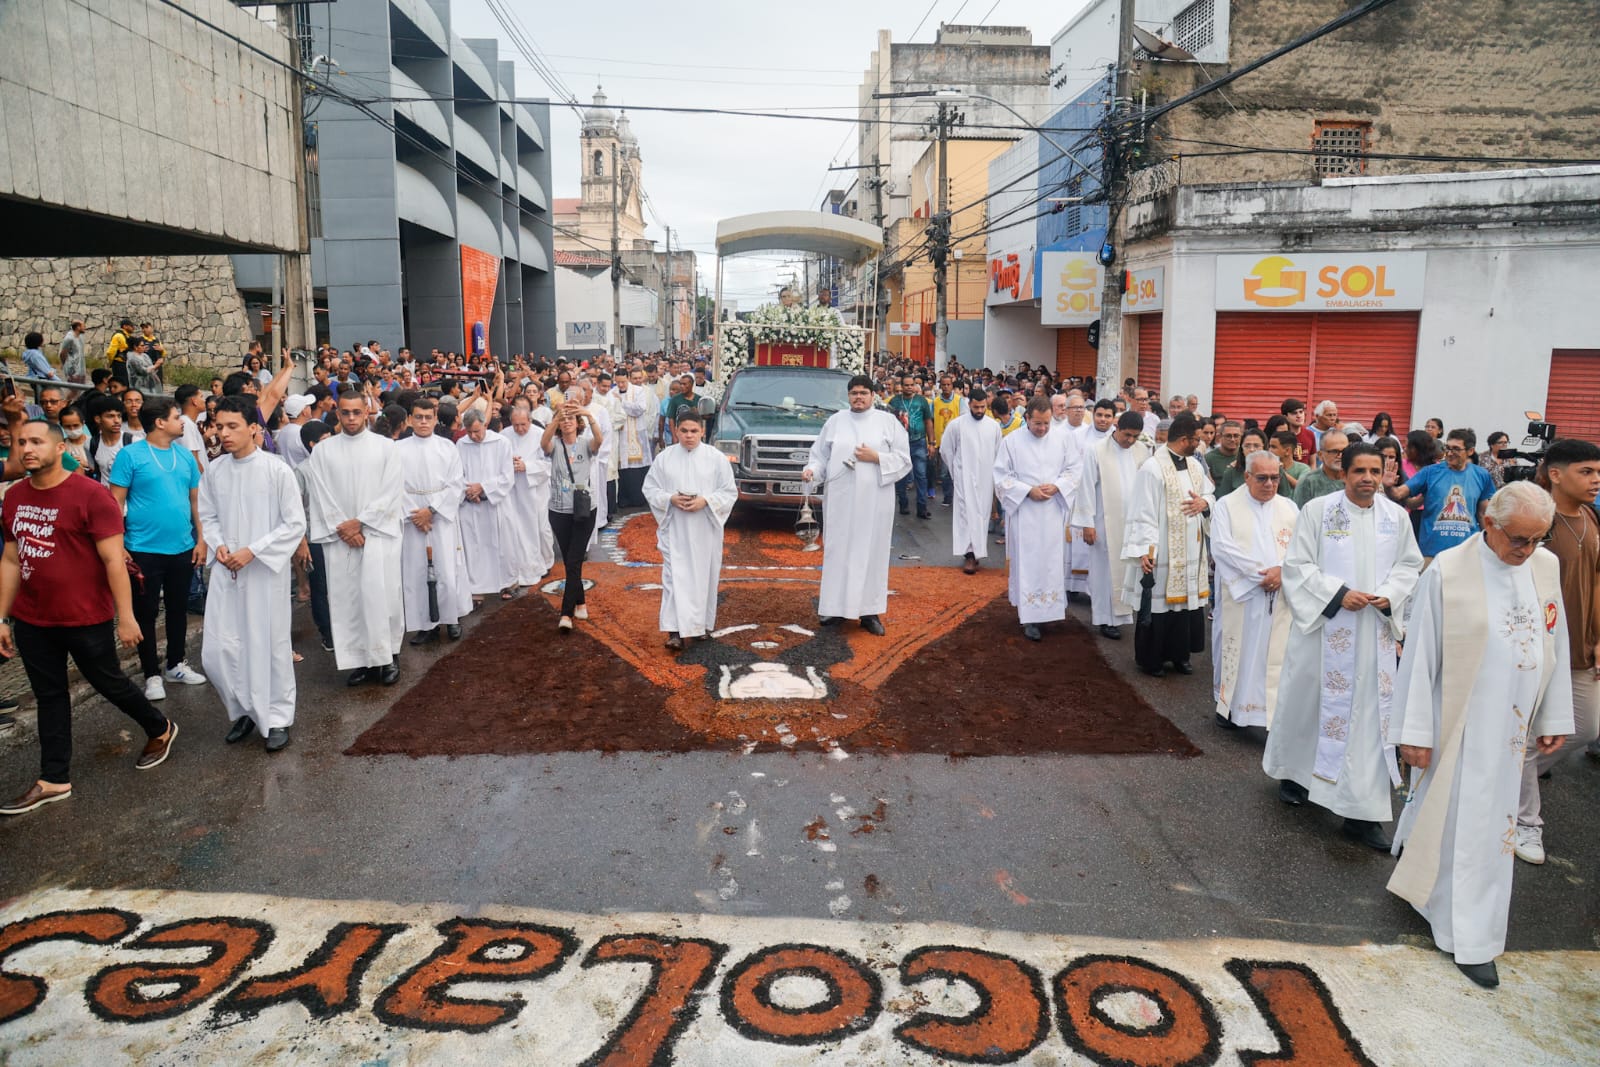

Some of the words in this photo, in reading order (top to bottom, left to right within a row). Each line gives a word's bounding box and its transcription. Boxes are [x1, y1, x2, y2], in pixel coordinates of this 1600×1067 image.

[1140, 279, 1156, 299] SOL
[1316, 265, 1395, 298] SOL
[1056, 291, 1102, 312] SOL
[1325, 299, 1384, 308] EMBALAGENS
